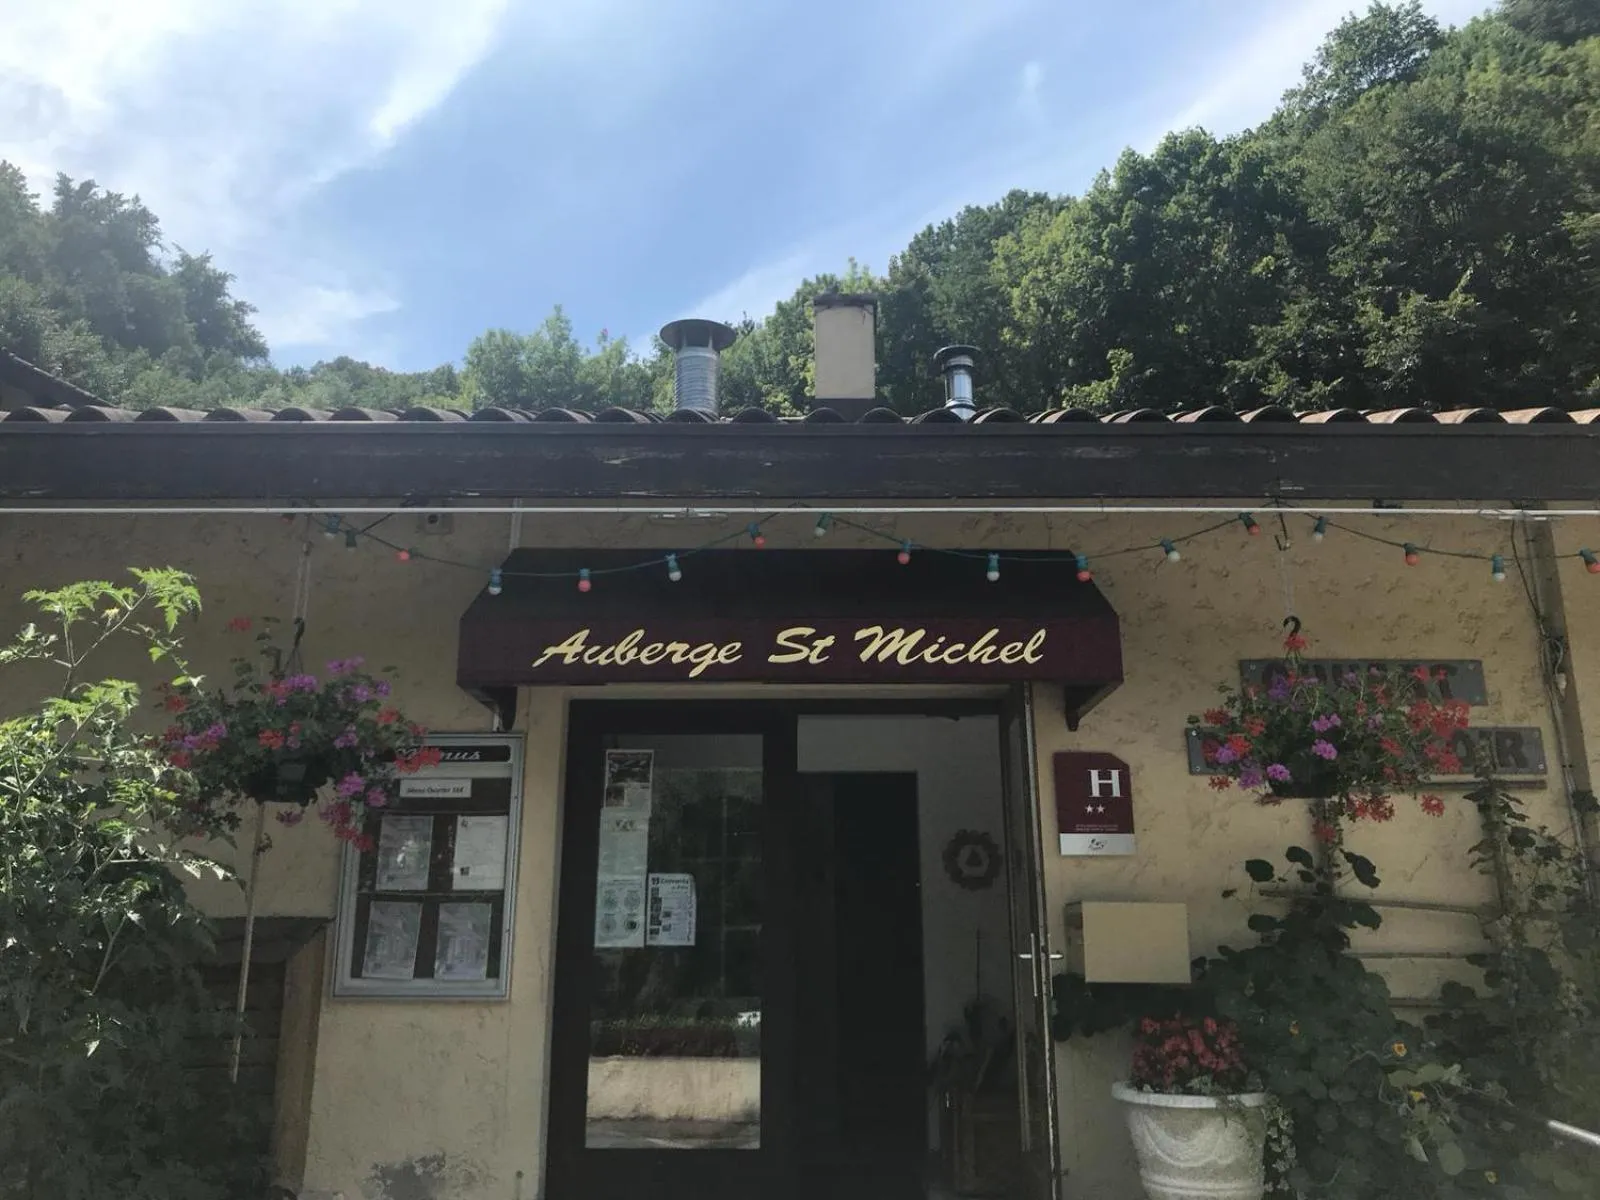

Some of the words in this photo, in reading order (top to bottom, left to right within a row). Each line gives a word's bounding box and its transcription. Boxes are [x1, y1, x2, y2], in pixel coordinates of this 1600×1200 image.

[532, 629, 742, 678] Auberge
[768, 627, 836, 664] St
[854, 625, 1046, 665] Michel
[1088, 768, 1124, 798] H
